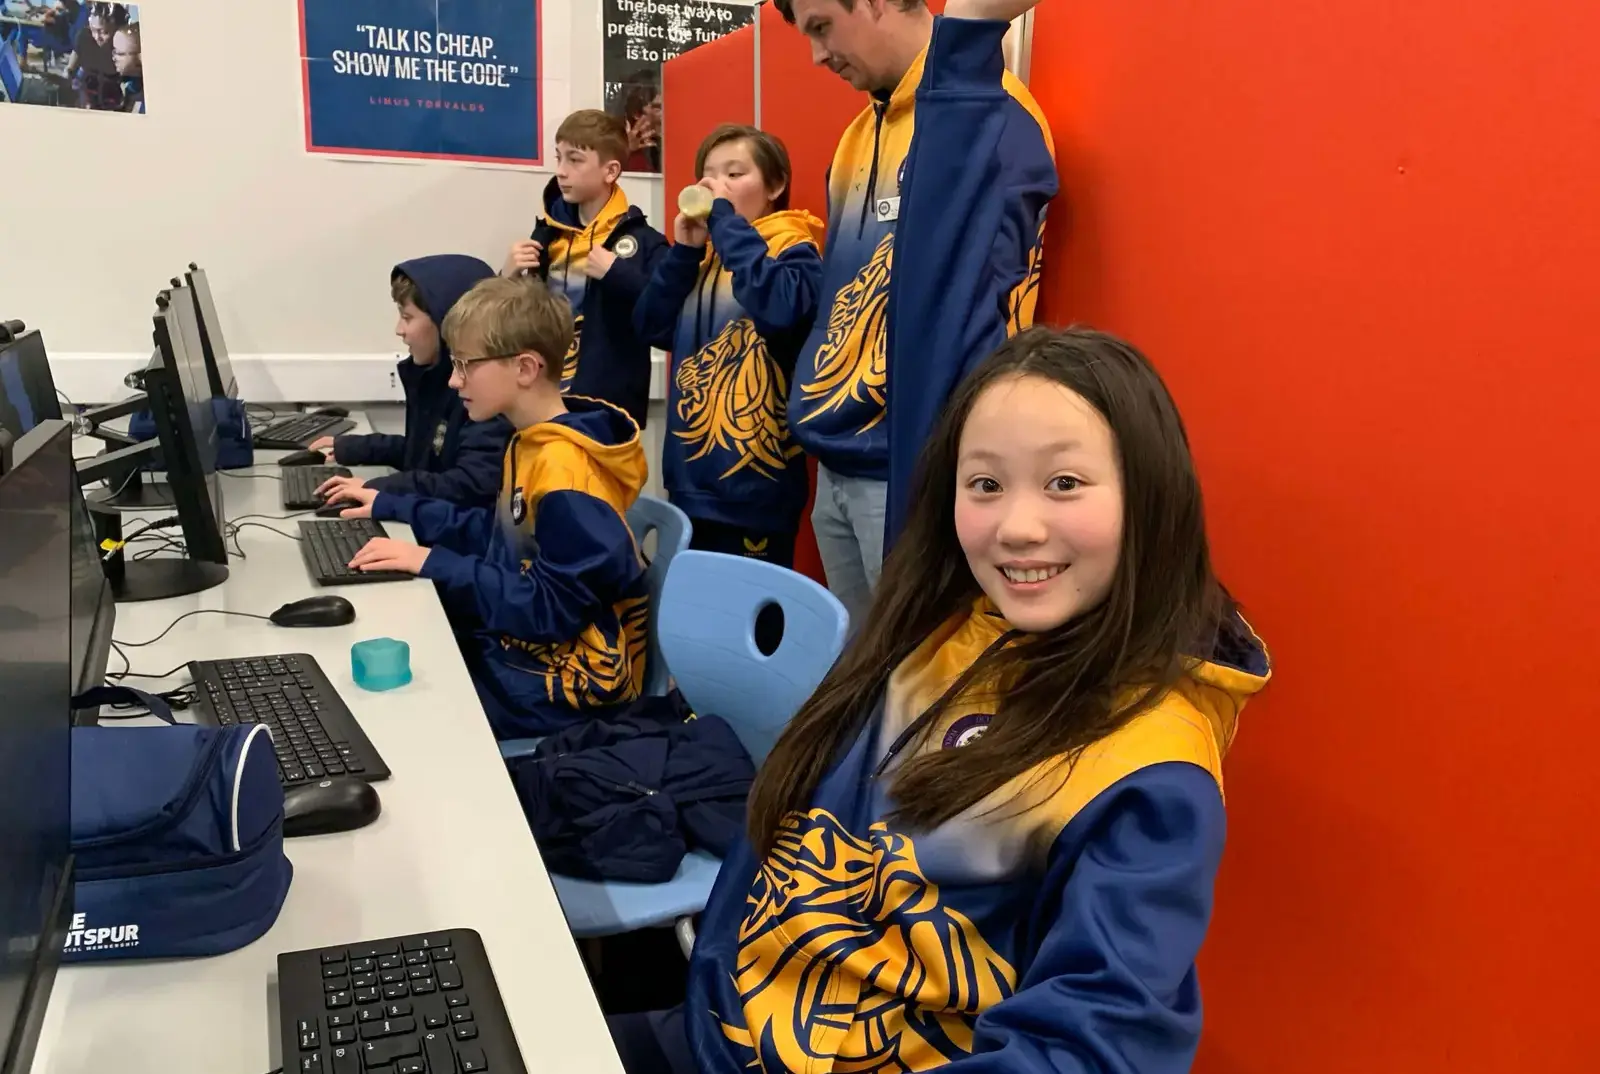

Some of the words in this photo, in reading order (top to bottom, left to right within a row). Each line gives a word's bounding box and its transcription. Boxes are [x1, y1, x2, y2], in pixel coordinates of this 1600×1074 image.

[617, 0, 644, 12] the
[648, 0, 680, 15] best
[683, 4, 712, 22] way
[716, 8, 733, 21] to
[607, 22, 664, 38] predict
[667, 27, 692, 42] the
[414, 30, 432, 54] IS
[436, 32, 497, 60] CHEAP.
[626, 45, 639, 60] is
[642, 48, 659, 61] to
[332, 50, 390, 78] SHOW
[394, 56, 421, 81] ME
[424, 59, 457, 83] THE
[417, 99, 485, 112] TORVALDS
[86, 941, 140, 951] MEMBERSHIP
